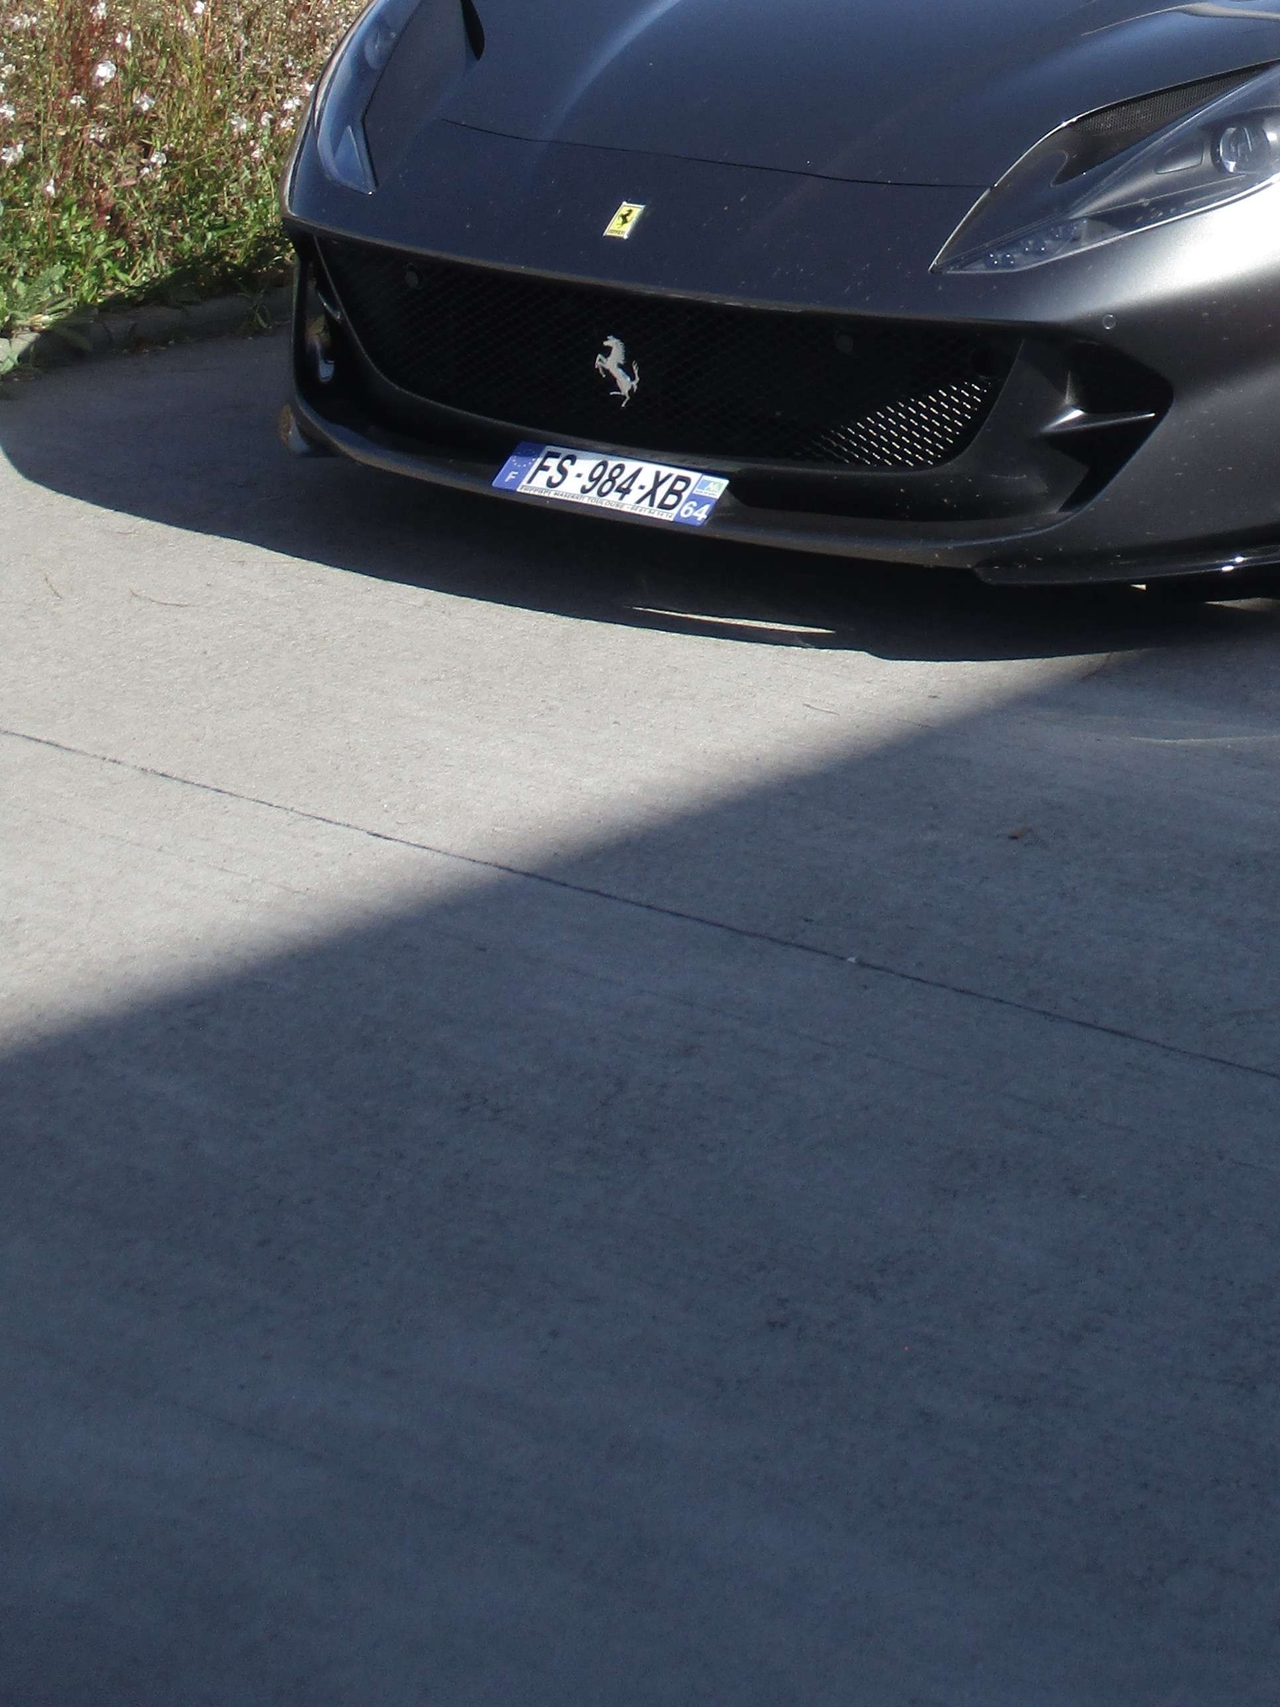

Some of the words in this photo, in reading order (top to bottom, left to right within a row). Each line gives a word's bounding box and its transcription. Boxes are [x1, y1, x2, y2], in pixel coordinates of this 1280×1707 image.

[504, 470, 519, 483] F
[526, 451, 692, 512] FS-984-XB
[680, 500, 711, 521] 64
